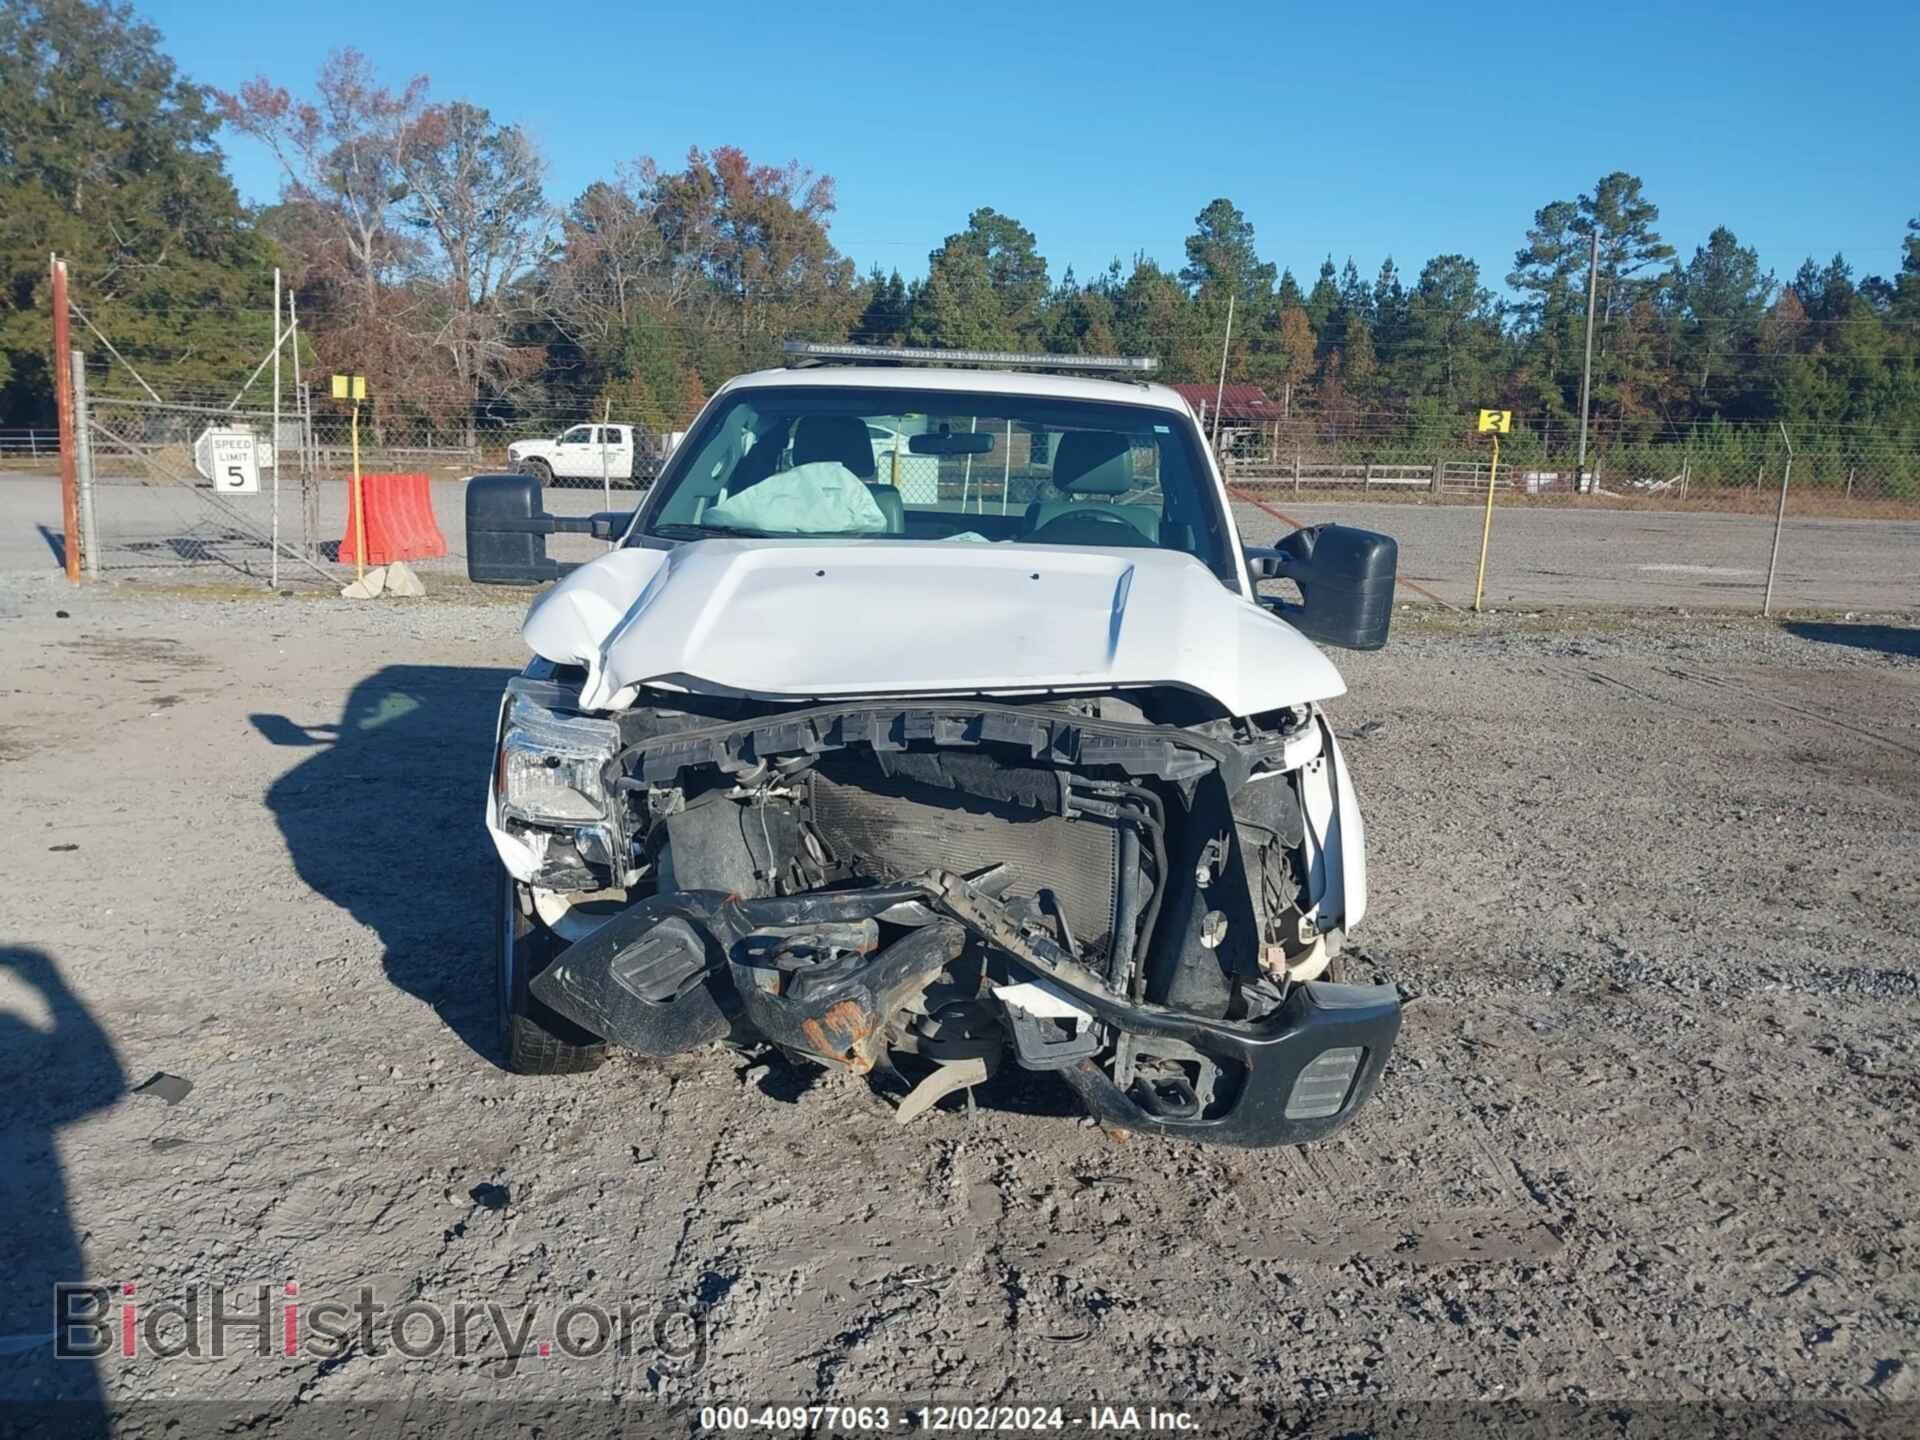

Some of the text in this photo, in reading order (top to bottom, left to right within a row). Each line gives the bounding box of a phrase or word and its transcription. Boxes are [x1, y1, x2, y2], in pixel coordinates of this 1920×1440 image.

[1487, 412, 1503, 432] 3
[214, 439, 252, 449] SPEED
[220, 452, 248, 462] LIMIT
[228, 466, 245, 487] 5
